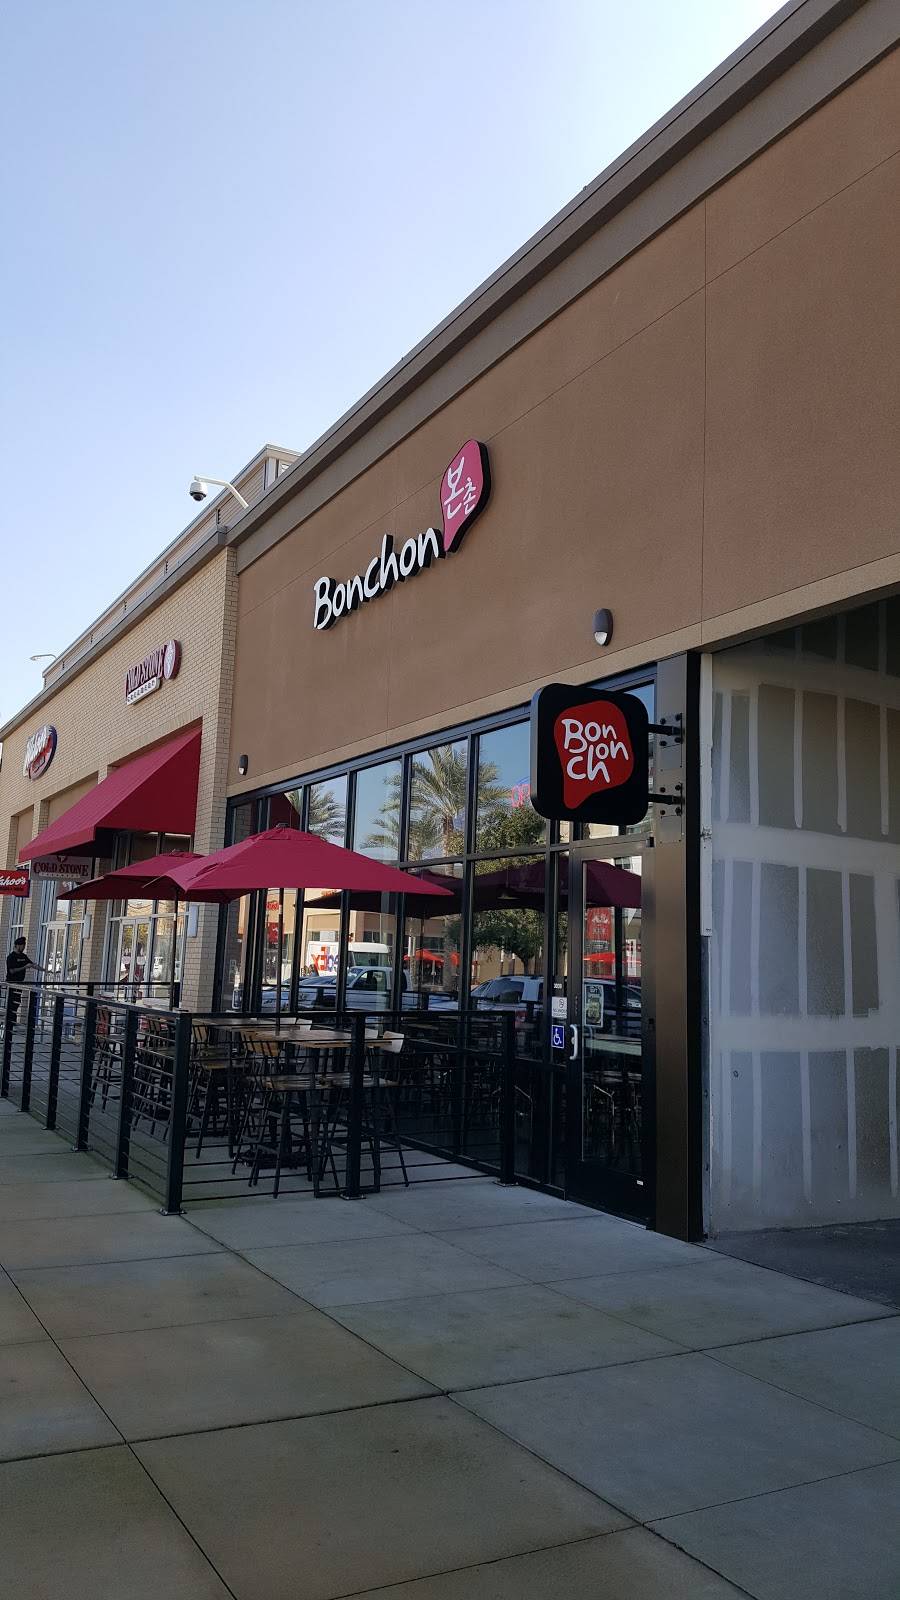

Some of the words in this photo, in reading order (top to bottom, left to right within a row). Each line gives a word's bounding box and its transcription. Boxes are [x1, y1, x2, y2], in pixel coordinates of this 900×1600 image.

[313, 527, 440, 630] Bonchon
[561, 719, 617, 754] Bon
[0, 876, 26, 886] ahoo's
[34, 862, 58, 873] COLD
[59, 863, 89, 877] STONE
